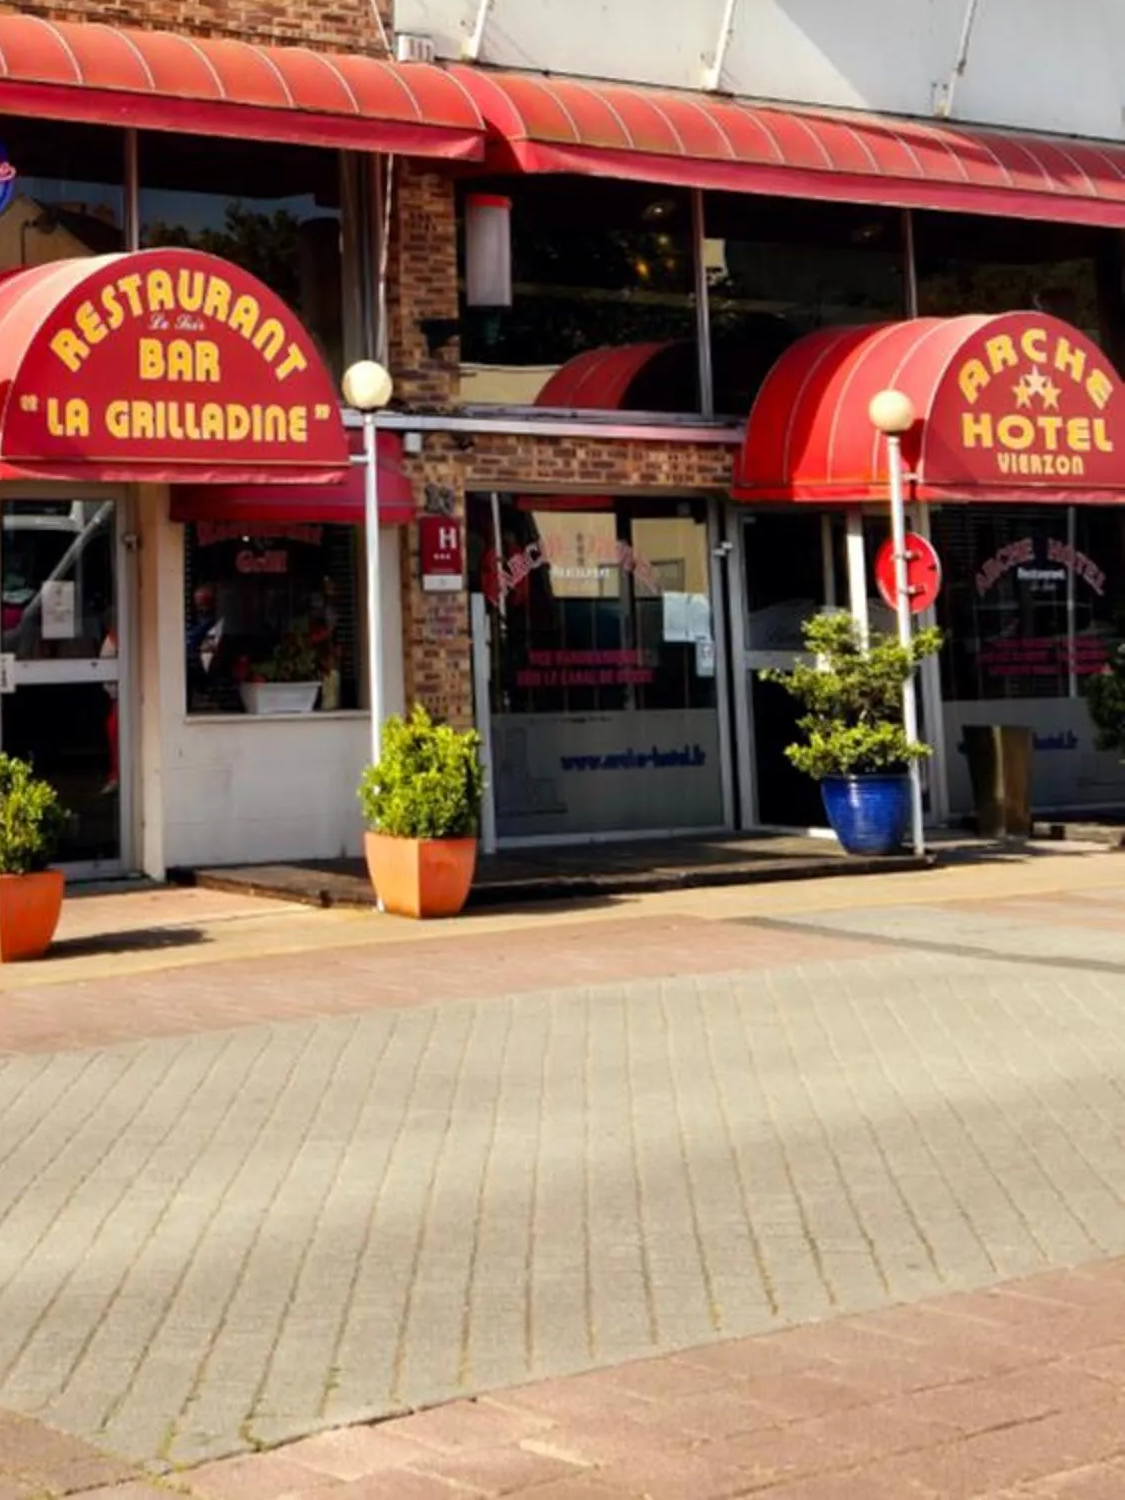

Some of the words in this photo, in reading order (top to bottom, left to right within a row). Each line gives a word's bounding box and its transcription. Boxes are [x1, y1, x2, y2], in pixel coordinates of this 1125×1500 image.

[49, 268, 308, 382] RESTAURANT
[139, 338, 220, 383] BAR
[958, 328, 1114, 411] ARCHE
[962, 411, 1114, 453] HOTEL
[997, 451, 1084, 476] VIERZON
[439, 527, 456, 550] H
